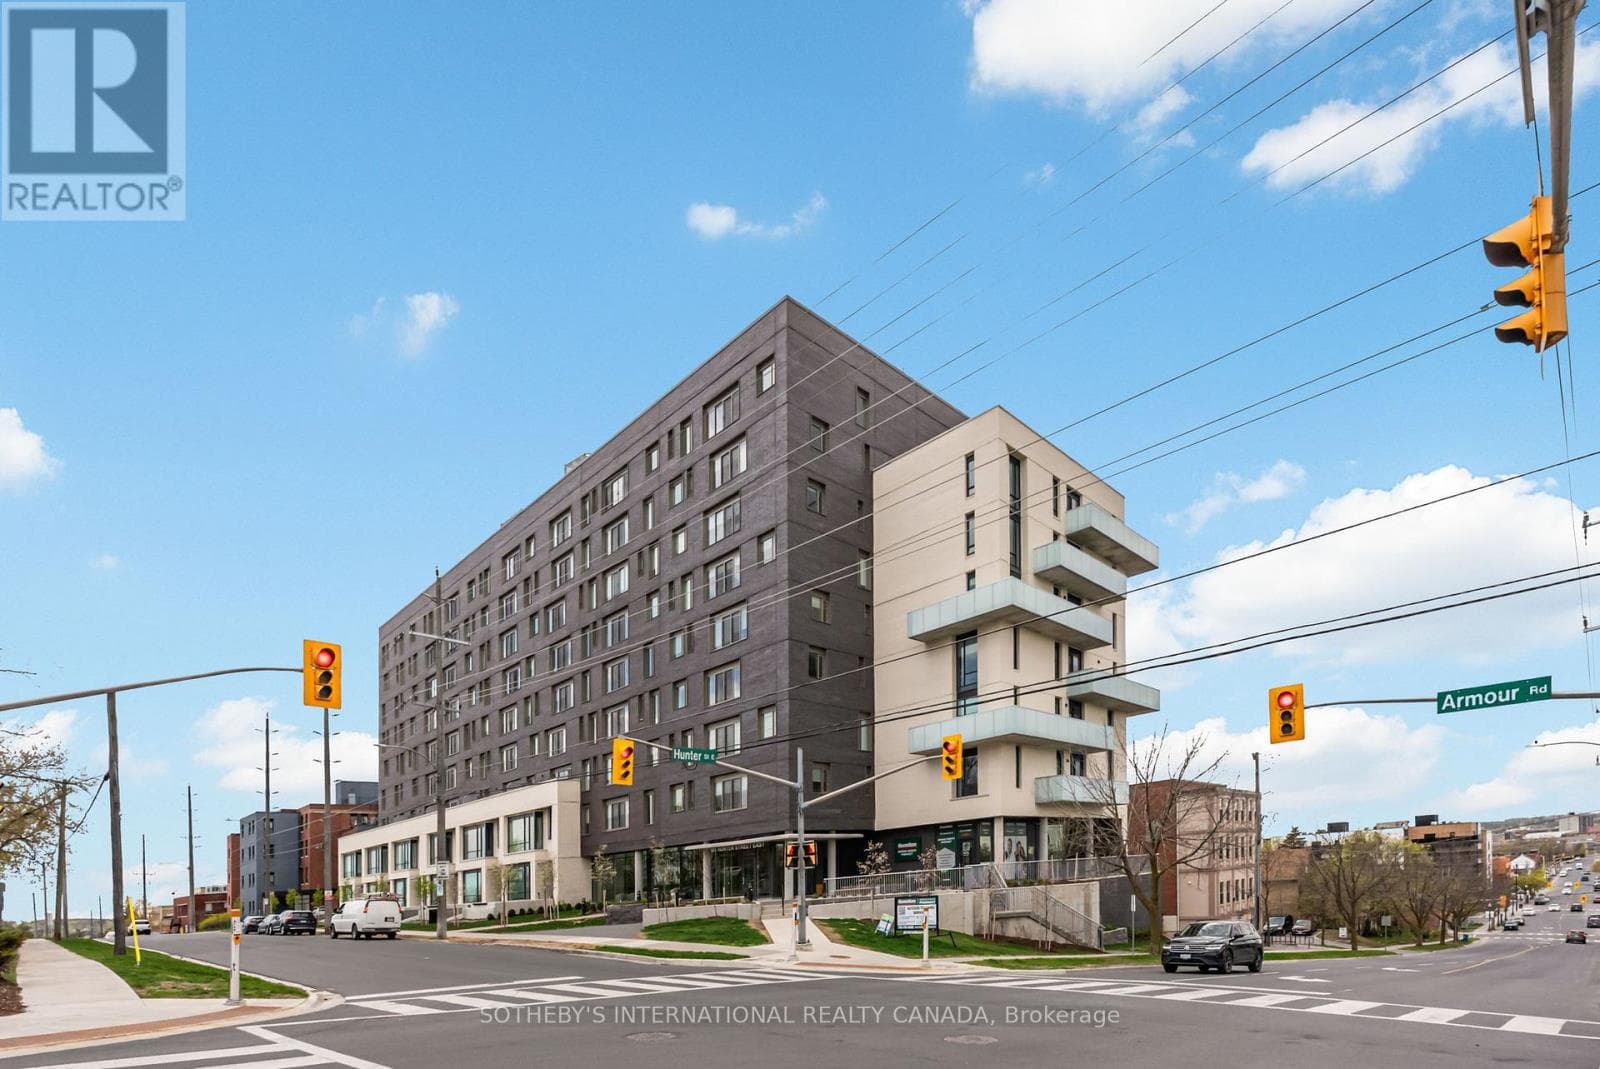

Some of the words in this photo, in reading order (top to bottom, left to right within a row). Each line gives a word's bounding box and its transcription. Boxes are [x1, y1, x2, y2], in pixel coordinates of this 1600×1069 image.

[1442, 687, 1520, 711] Armour
[1530, 684, 1548, 695] Rd
[673, 748, 702, 761] Hunter
